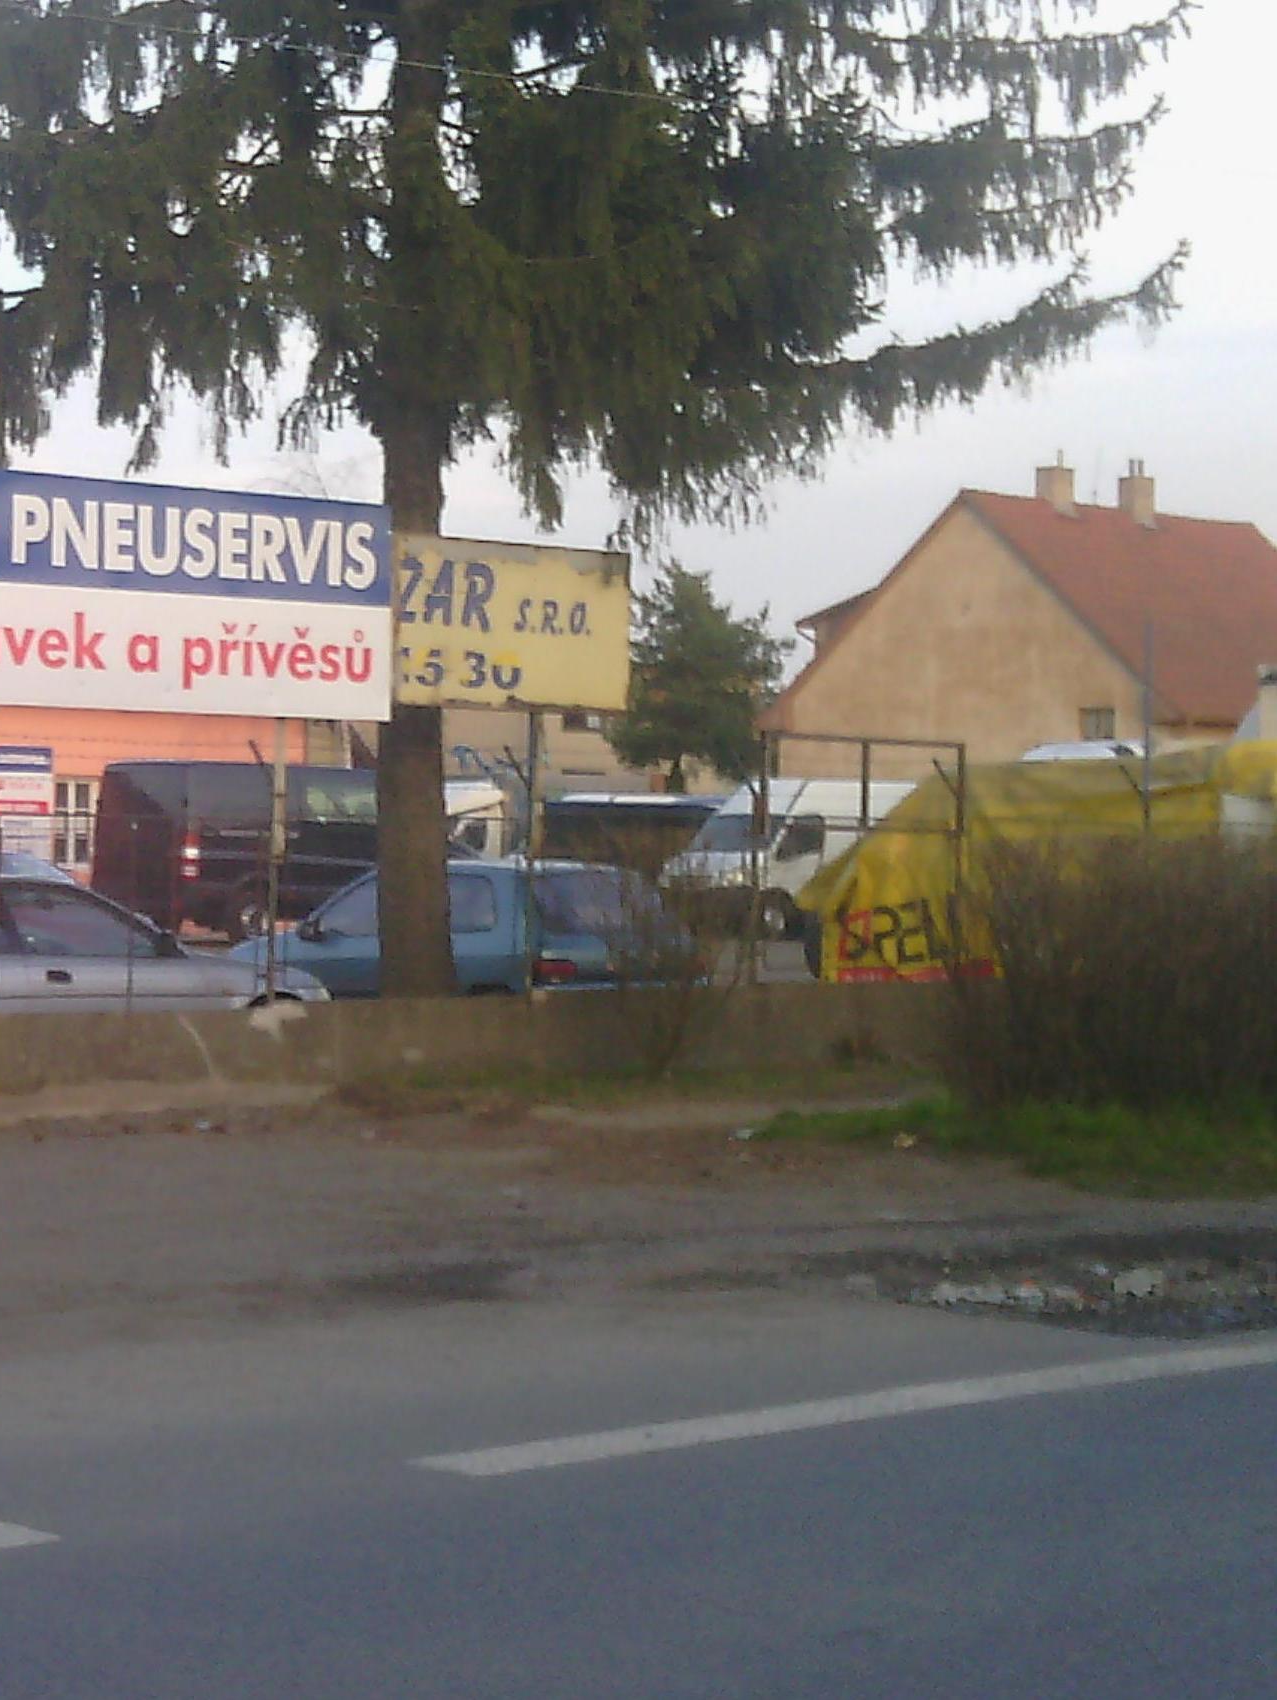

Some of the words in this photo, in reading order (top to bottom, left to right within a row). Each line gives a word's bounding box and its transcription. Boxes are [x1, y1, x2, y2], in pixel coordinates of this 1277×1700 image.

[10, 494, 377, 590] PNEUSERVIS
[127, 632, 160, 673] a
[183, 620, 373, 688] přívěsů
